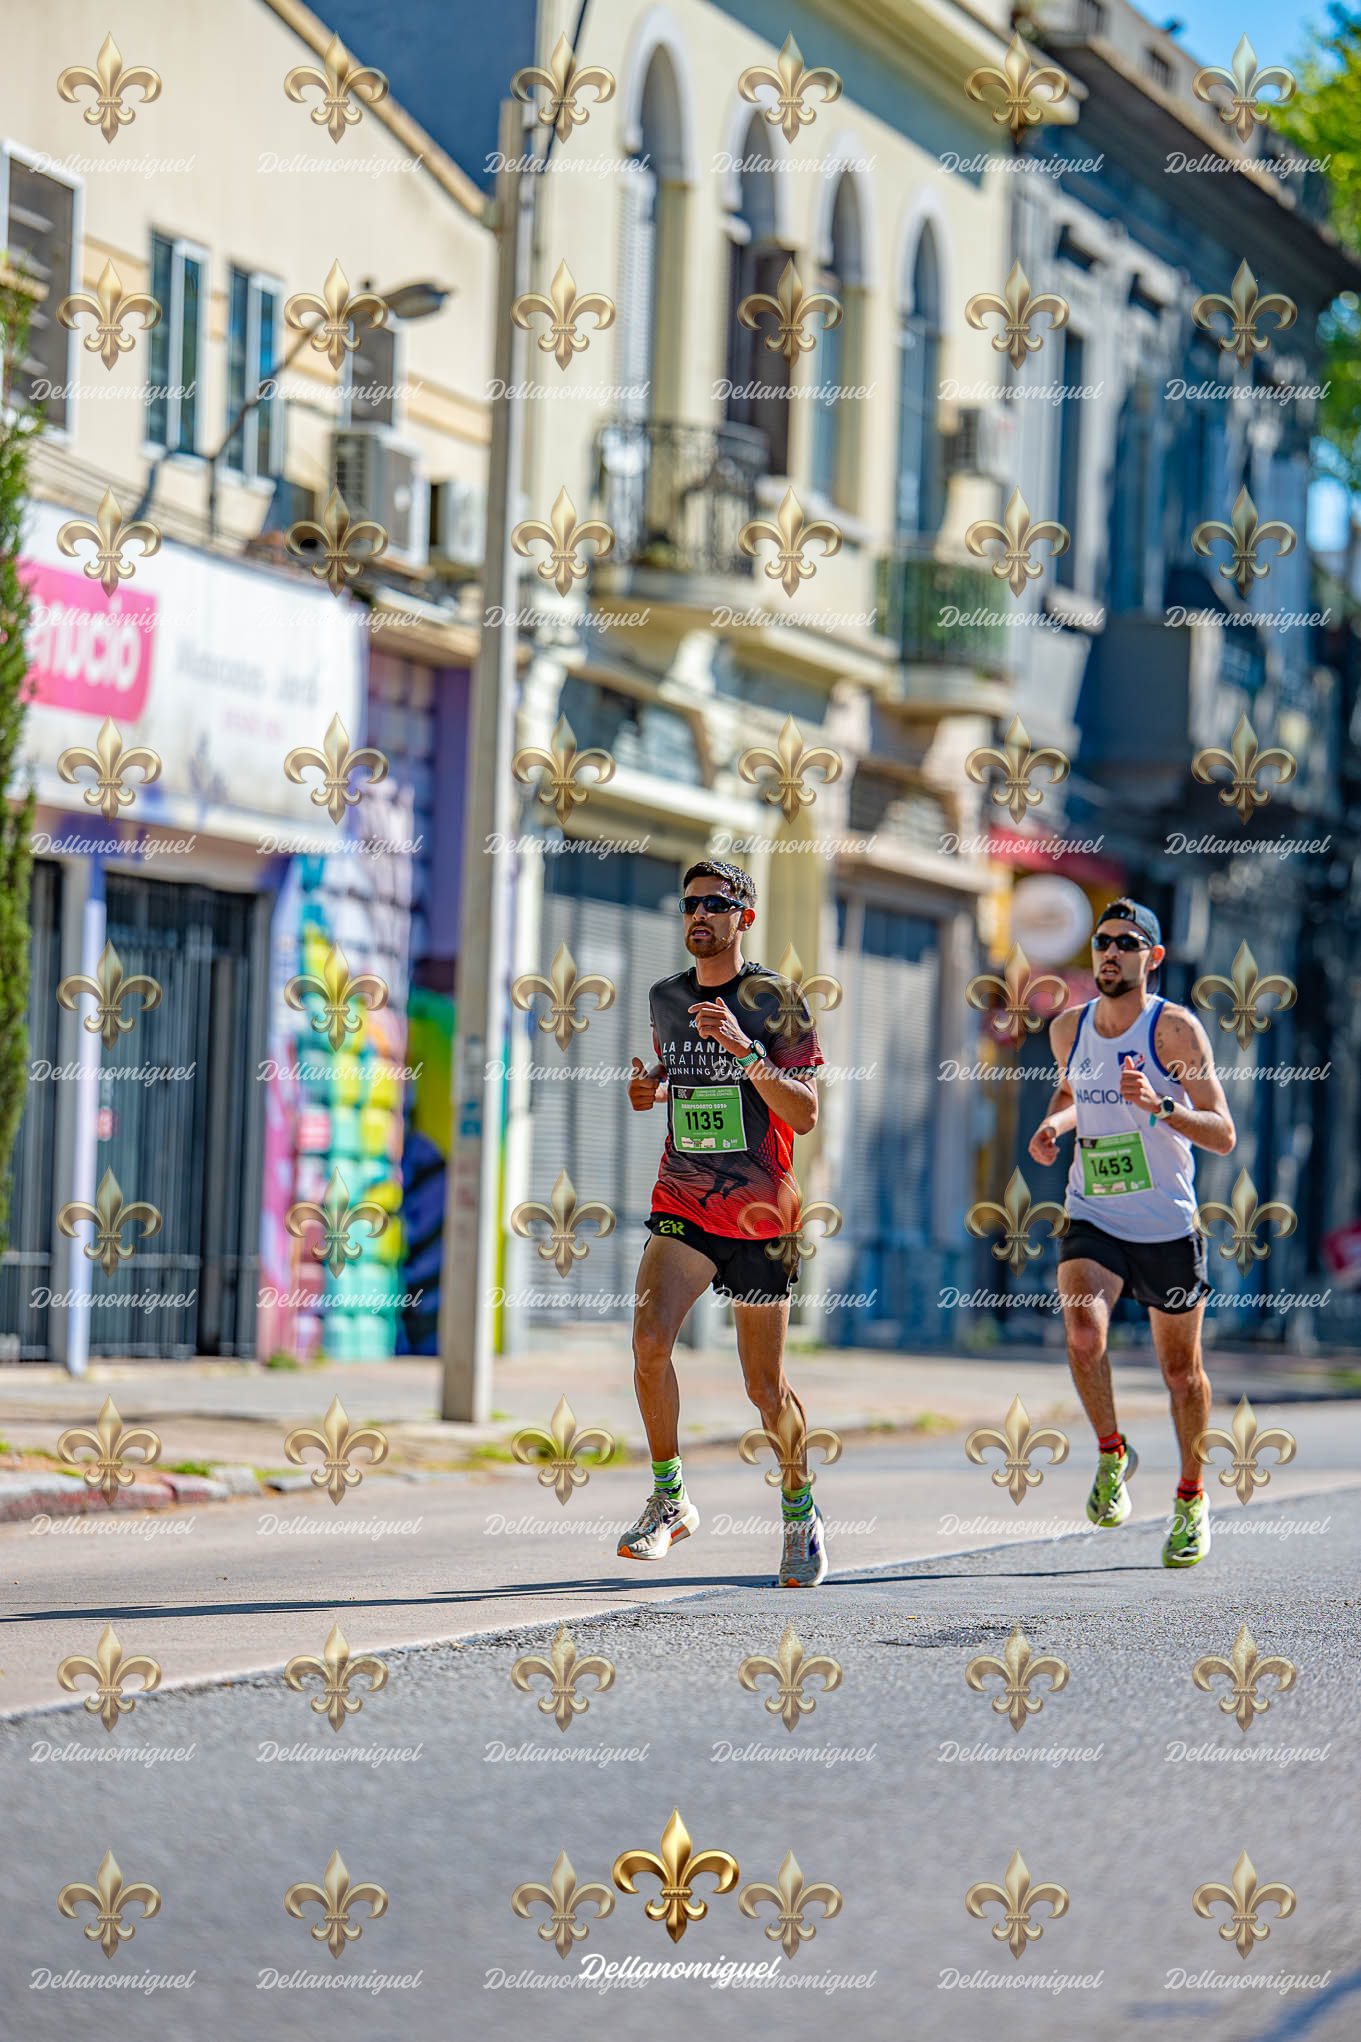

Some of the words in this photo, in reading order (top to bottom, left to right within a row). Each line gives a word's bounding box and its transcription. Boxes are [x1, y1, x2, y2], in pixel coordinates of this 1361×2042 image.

[663, 1042, 676, 1053] LA
[683, 1041, 729, 1053] BAND
[668, 1068, 711, 1076] RUNNING
[1075, 1090, 1134, 1105] NACIO
[685, 1111, 724, 1130] 1135
[1090, 1156, 1134, 1177] 1453
